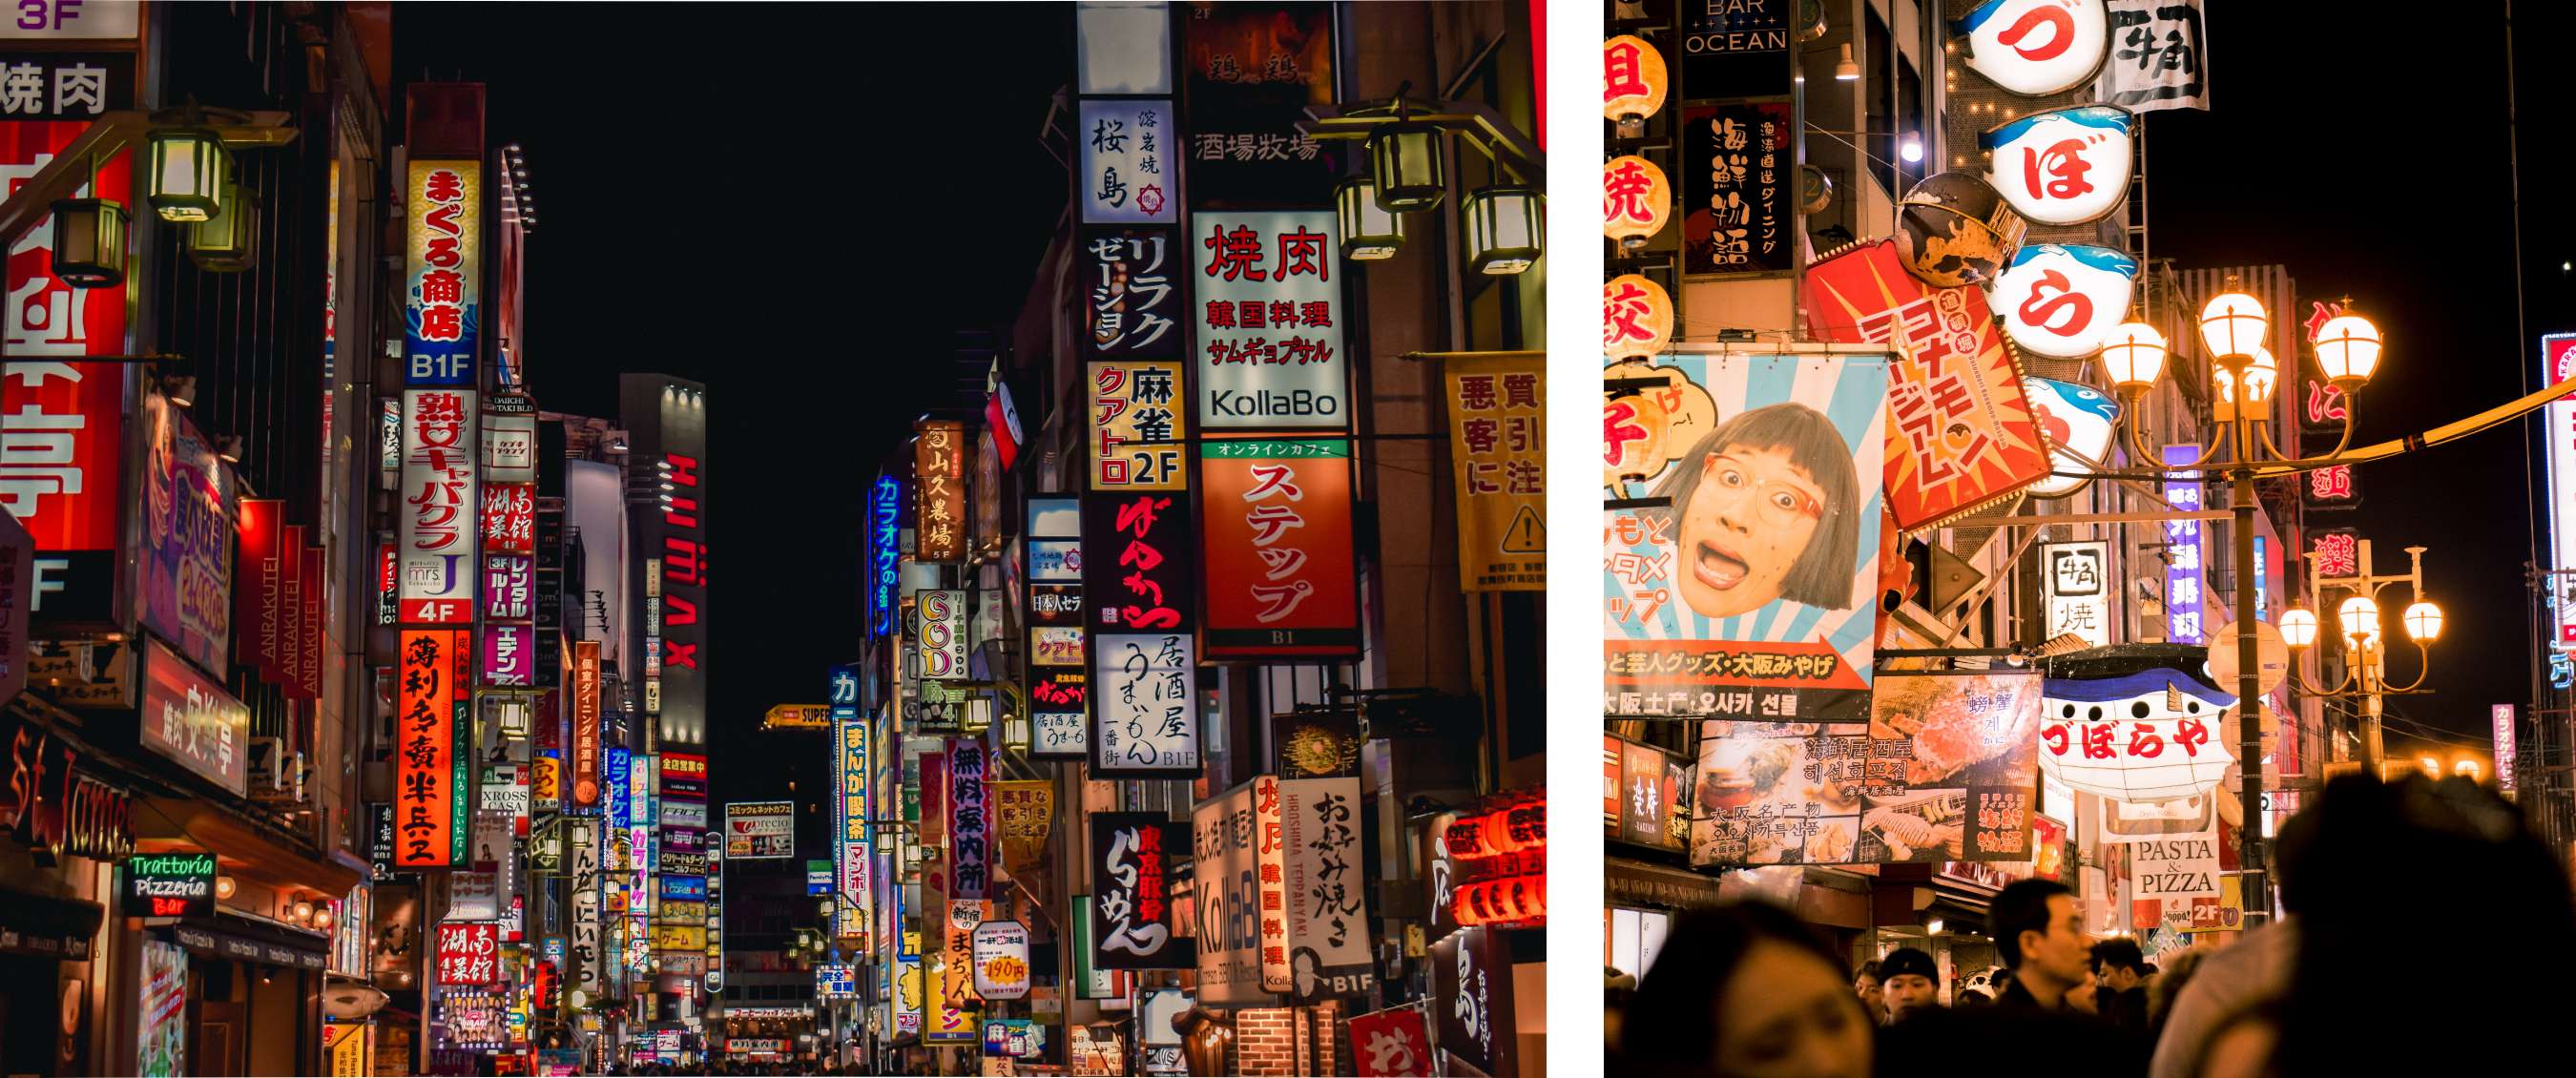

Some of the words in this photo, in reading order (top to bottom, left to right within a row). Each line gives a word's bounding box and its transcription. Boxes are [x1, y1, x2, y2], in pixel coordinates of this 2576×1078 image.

[17, 1, 83, 31] 3F
[1707, 0, 1765, 16] BAR
[1686, 31, 1786, 52] OCEAN
[2116, 26, 2194, 80] 牛角
[0, 62, 108, 115] 焼肉
[1137, 110, 1161, 175] 溶岩焼
[1195, 134, 1321, 161] 酒場牧場
[1091, 118, 1130, 209] 桜島
[2024, 133, 2107, 200] ぼ
[1711, 116, 1751, 266] 海鮮物語
[419, 170, 466, 342] まぐろ商店
[1204, 223, 1330, 282] 焼肉
[1089, 237, 1126, 351] ゼーション
[1128, 236, 1174, 349] リラク
[2018, 269, 2094, 338] ら
[1206, 300, 1333, 330] 韓国料理
[411, 353, 471, 379] B1F
[1206, 337, 1334, 366] サムギョプサル
[1131, 366, 1174, 446] 麻雀
[1211, 389, 1338, 417] KollaBo
[1459, 375, 1539, 411] 悪質
[1096, 365, 1130, 485] クアトロ
[1462, 415, 1539, 454] 客引
[1217, 442, 1332, 456] オンラインカフェ
[1132, 451, 1179, 484] 2F
[1465, 461, 1543, 495] に注
[488, 487, 533, 514] 湖南
[488, 514, 532, 540] 菜館
[1242, 463, 1314, 623] ステップ
[1604, 516, 1672, 547] もと
[1604, 552, 1671, 585] タメ
[2059, 561, 2097, 587] 牛角
[489, 573, 509, 618] ルーム
[509, 559, 529, 619] レンタル
[260, 557, 279, 663] ANRAKUTEI
[417, 601, 454, 622] 4F
[282, 579, 300, 682] ANRAKUTEI
[1271, 631, 1295, 645] B1
[302, 601, 320, 695] ANRAKUTEI
[497, 626, 517, 674] エデン
[1604, 653, 1835, 680] と芸人グッズ・大阪みやげ
[1153, 634, 1191, 738] 居酒屋
[1035, 714, 1080, 728] 居酒屋
[1760, 693, 1797, 716] 선물
[1103, 720, 1120, 766] 一番街
[1803, 738, 1913, 761] 海鮮居酒屋
[2041, 719, 2210, 759] づぼらや
[1162, 751, 1195, 765] B1F
[482, 791, 529, 806] XROSS
[612, 750, 628, 816] カラオケ
[846, 727, 864, 840] まんが喫茶
[954, 746, 987, 892] 無料案内所
[134, 855, 214, 876] Trattoria
[1287, 794, 1302, 857] HIROSHIMA
[1295, 861, 1309, 938] TEPPANYAKI
[2137, 840, 2213, 861] PASTA
[2167, 860, 2181, 873] &
[848, 843, 865, 906] マンボー
[1311, 791, 1361, 948] お好み焼き
[2140, 872, 2214, 894] PIZZA
[135, 876, 208, 897] Pizzeria
[152, 898, 190, 916] Bar
[1260, 862, 1285, 966] 韓国料理
[2193, 905, 2219, 921] 2F
[441, 925, 495, 955] 湖南
[451, 956, 494, 983] 菜館
[987, 961, 1025, 978] 190円
[1332, 974, 1374, 994] B1F
